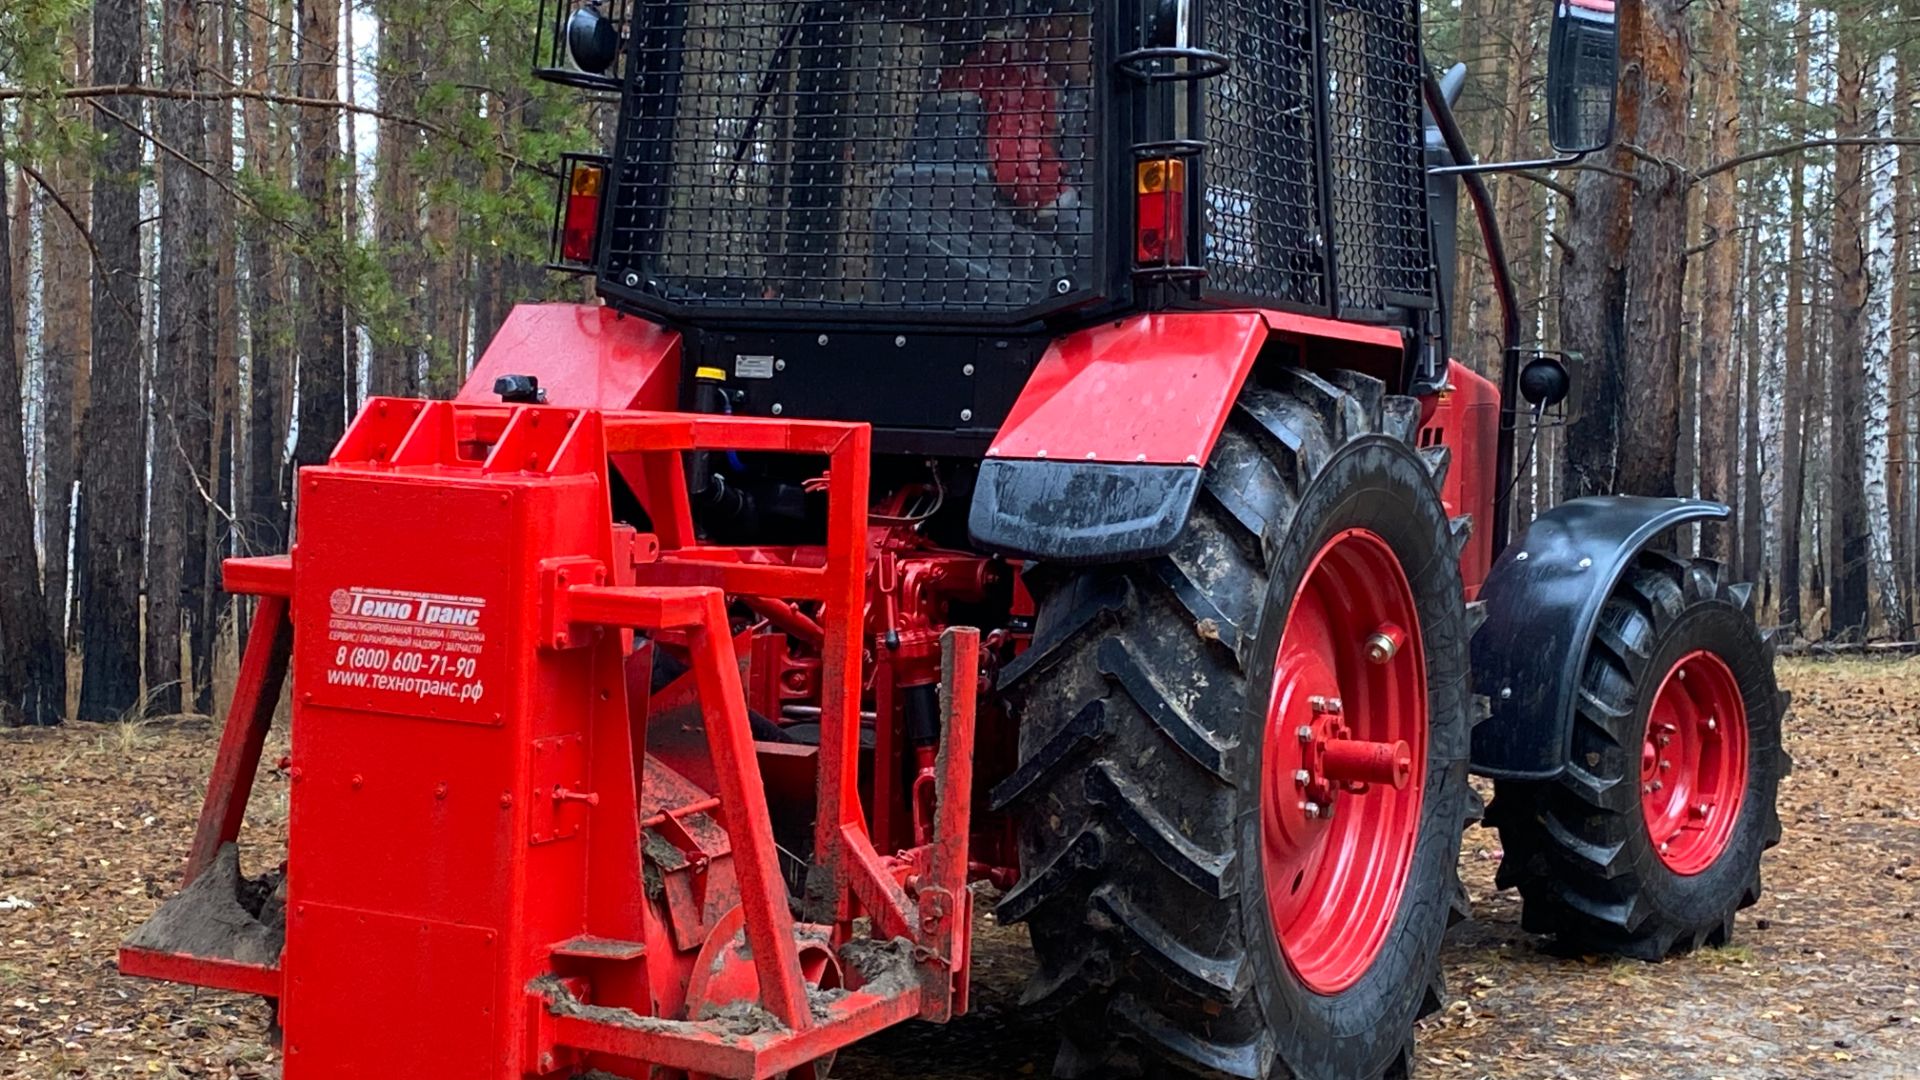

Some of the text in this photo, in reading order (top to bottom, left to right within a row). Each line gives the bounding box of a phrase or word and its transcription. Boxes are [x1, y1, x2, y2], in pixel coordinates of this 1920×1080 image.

[349, 592, 486, 626] Техно Транс
[336, 646, 476, 679] 8 (800) 600-71-90
[327, 669, 484, 704] www.технотранс.рф
